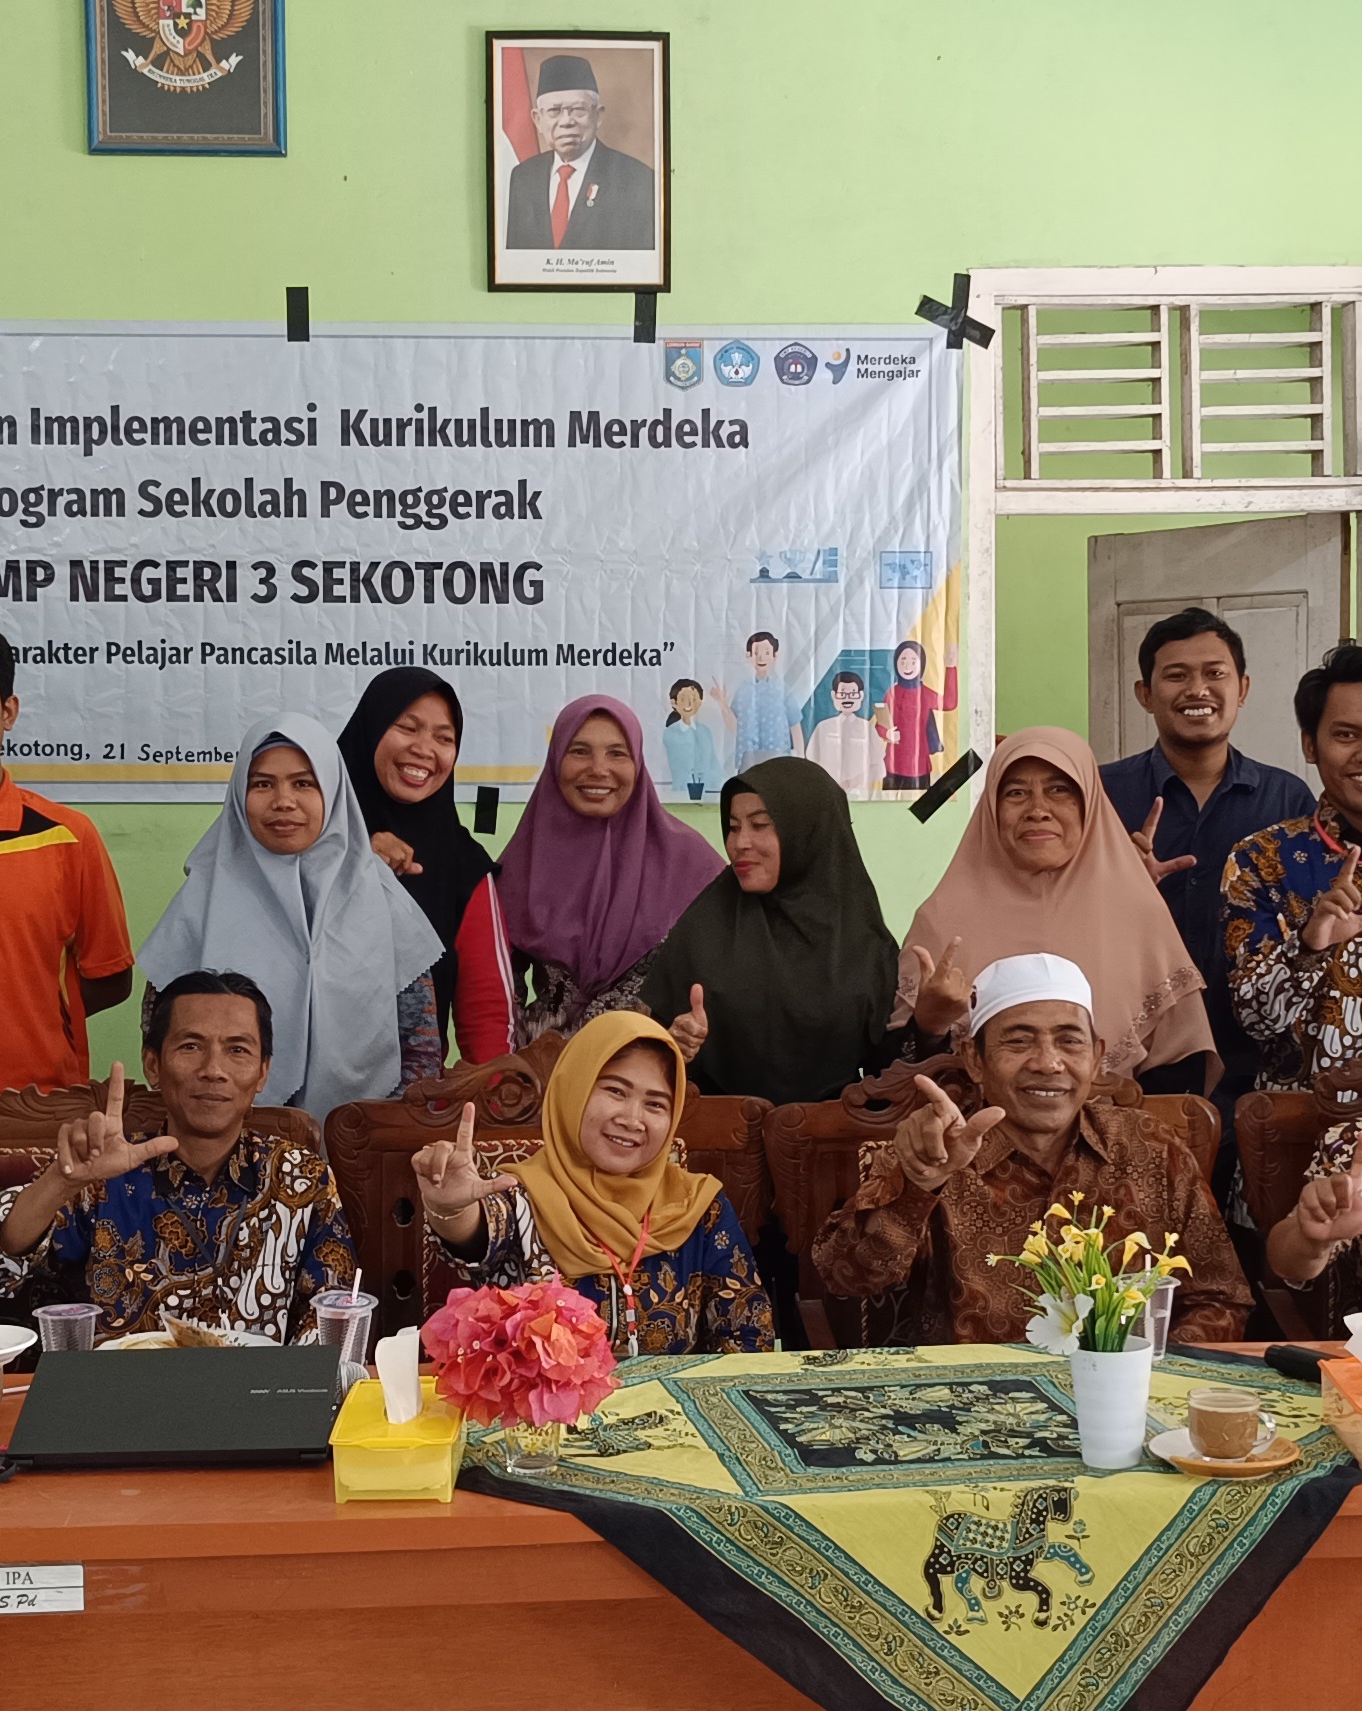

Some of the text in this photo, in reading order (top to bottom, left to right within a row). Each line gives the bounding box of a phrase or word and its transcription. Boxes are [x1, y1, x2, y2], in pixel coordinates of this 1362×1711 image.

[856, 353, 916, 366] Merdeka
[856, 367, 921, 381] Mengajar
[30, 402, 318, 458] Implementasi
[340, 402, 555, 449] Kurikulum
[567, 407, 750, 449] Merdeka
[137, 476, 308, 519] Sekolah
[320, 478, 543, 531] Penggerak
[68, 558, 238, 604] NEGERI
[250, 560, 278, 604] 3
[289, 559, 545, 606] SEKOTONG
[13, 638, 99, 665] arakter
[105, 638, 192, 671] Pelajar
[200, 638, 318, 666] Pancasila
[324, 640, 416, 667] Melalui
[422, 640, 548, 667] Kurikulum
[102, 742, 126, 760] 21
[6, 1571, 34, 1586] IPA
